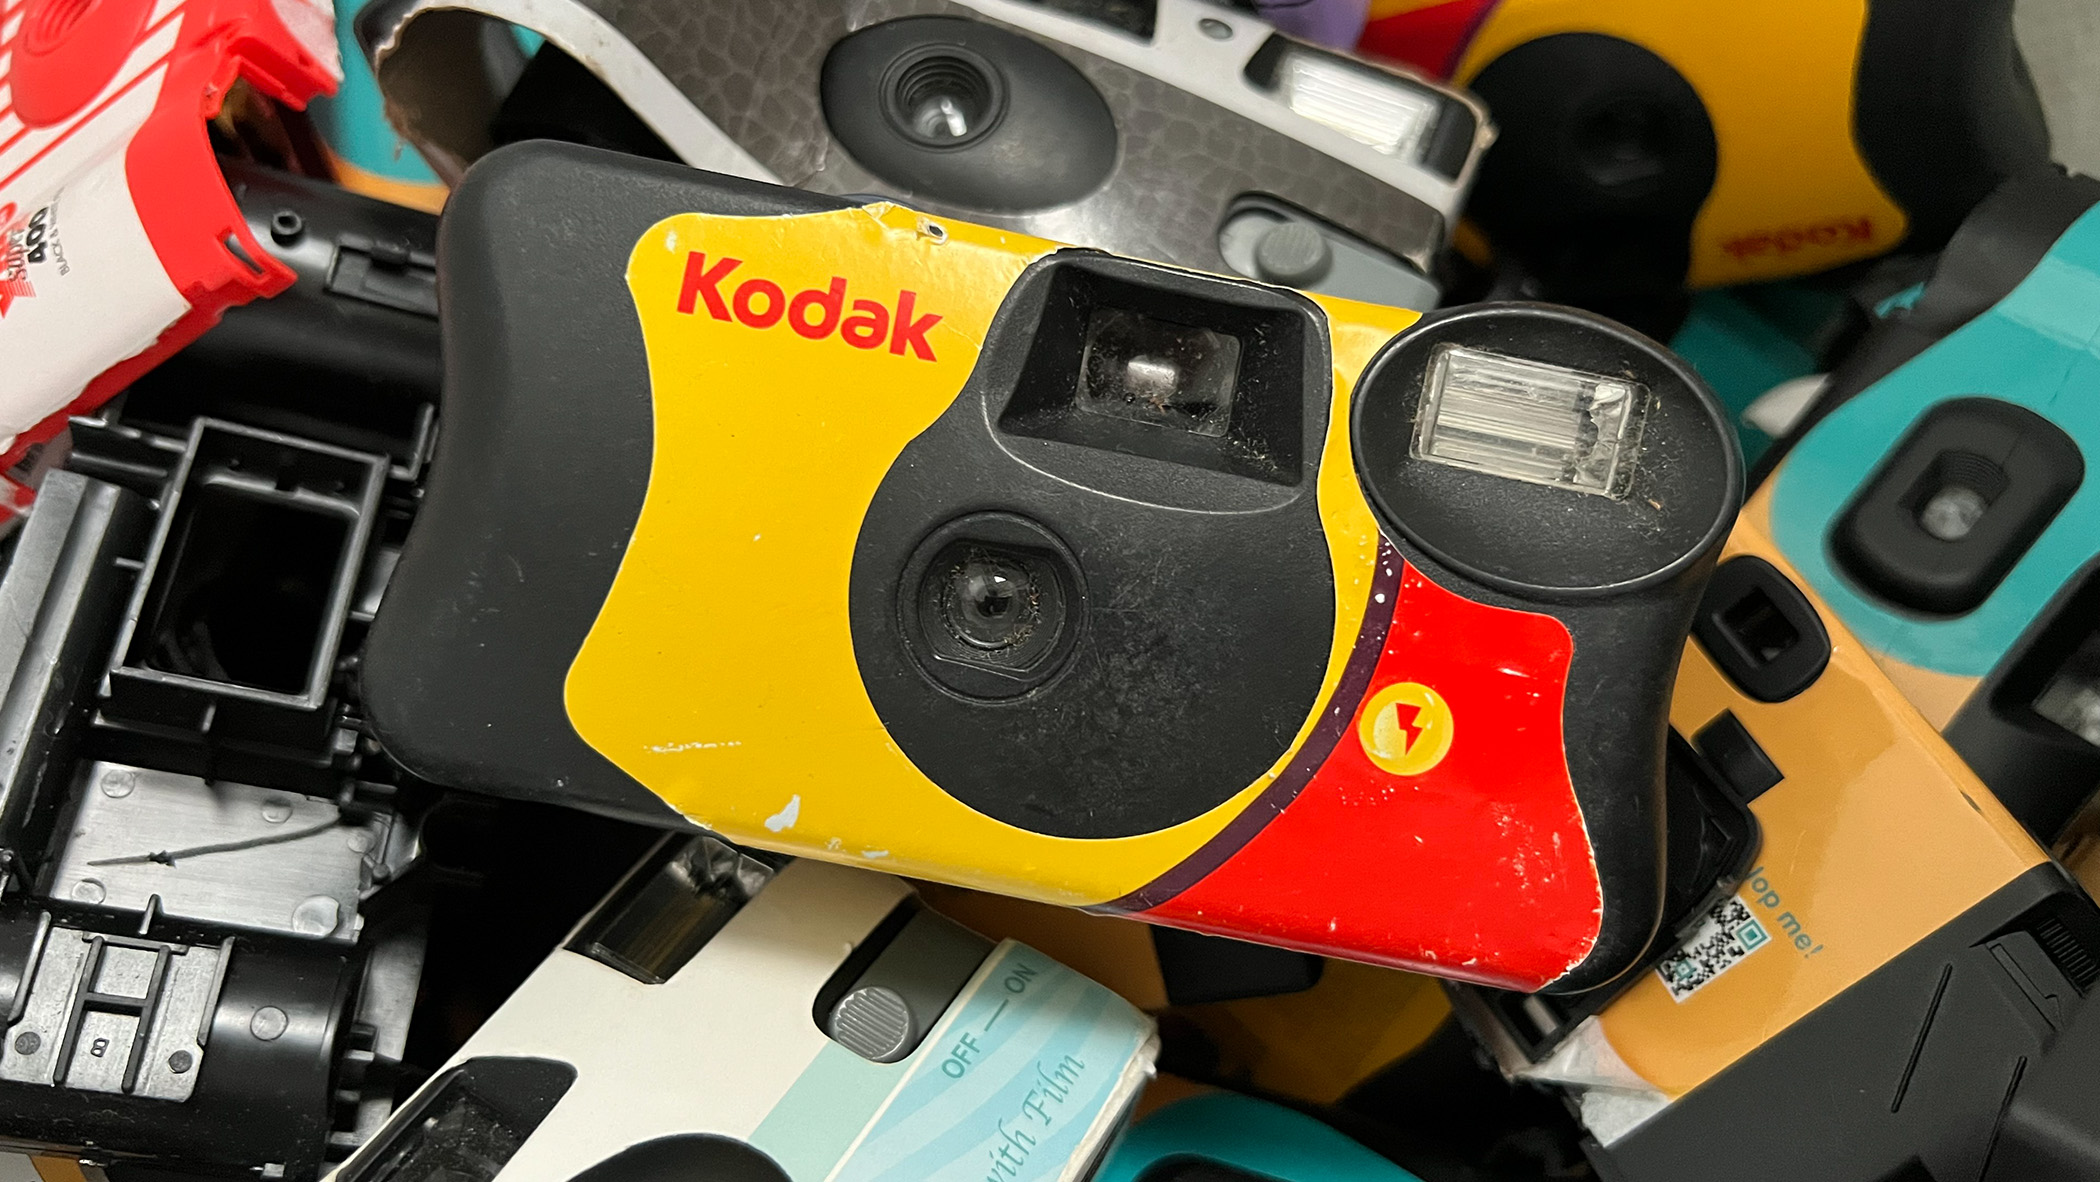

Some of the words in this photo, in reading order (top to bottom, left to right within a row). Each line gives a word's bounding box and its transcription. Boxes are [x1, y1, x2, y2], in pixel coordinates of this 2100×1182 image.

[26, 206, 49, 264] 400
[51, 238, 71, 276] BLACK
[676, 250, 944, 363] Kodak
[1777, 911, 1824, 959] me!
[941, 1032, 980, 1079] OFF
[1004, 962, 1039, 994] ON
[1021, 1054, 1085, 1126] Film
